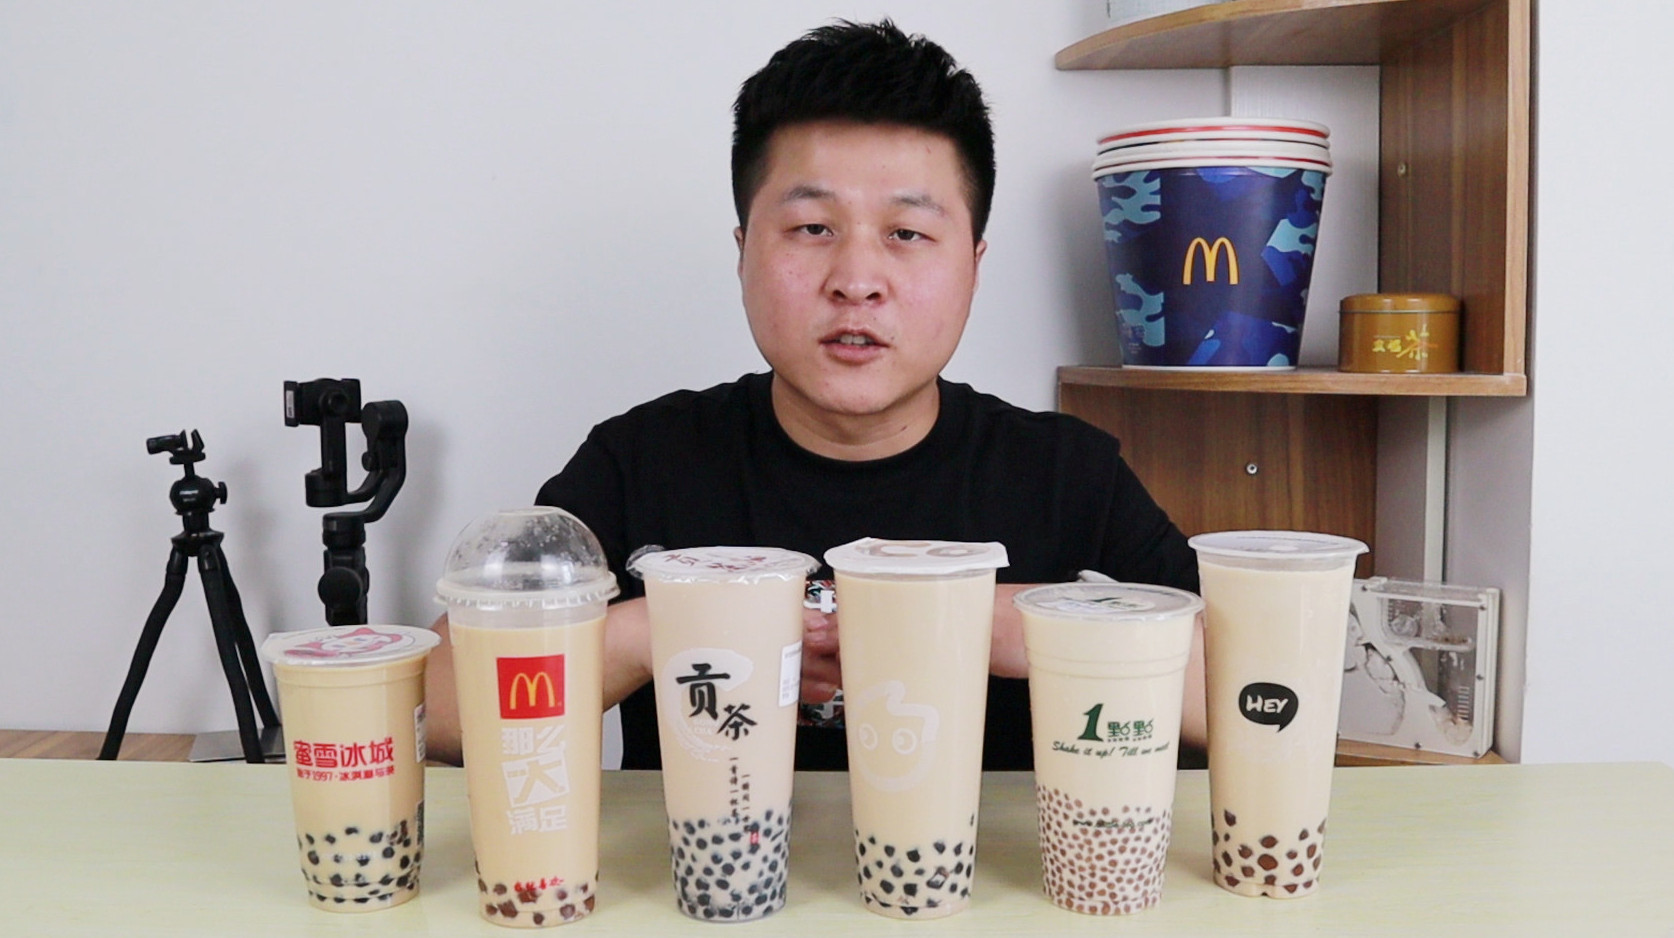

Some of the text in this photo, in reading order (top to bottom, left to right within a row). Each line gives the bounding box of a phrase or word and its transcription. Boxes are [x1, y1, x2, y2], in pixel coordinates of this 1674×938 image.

[1182, 236, 1238, 285] M
[509, 671, 556, 710] M
[676, 662, 758, 741] 贡茶
[1246, 694, 1289, 713] HEY
[294, 737, 395, 768] 蜜雪冰城
[501, 724, 567, 756] 那么
[1052, 741, 1080, 755] Shake
[504, 756, 567, 806] 大
[506, 805, 567, 835] 满足
